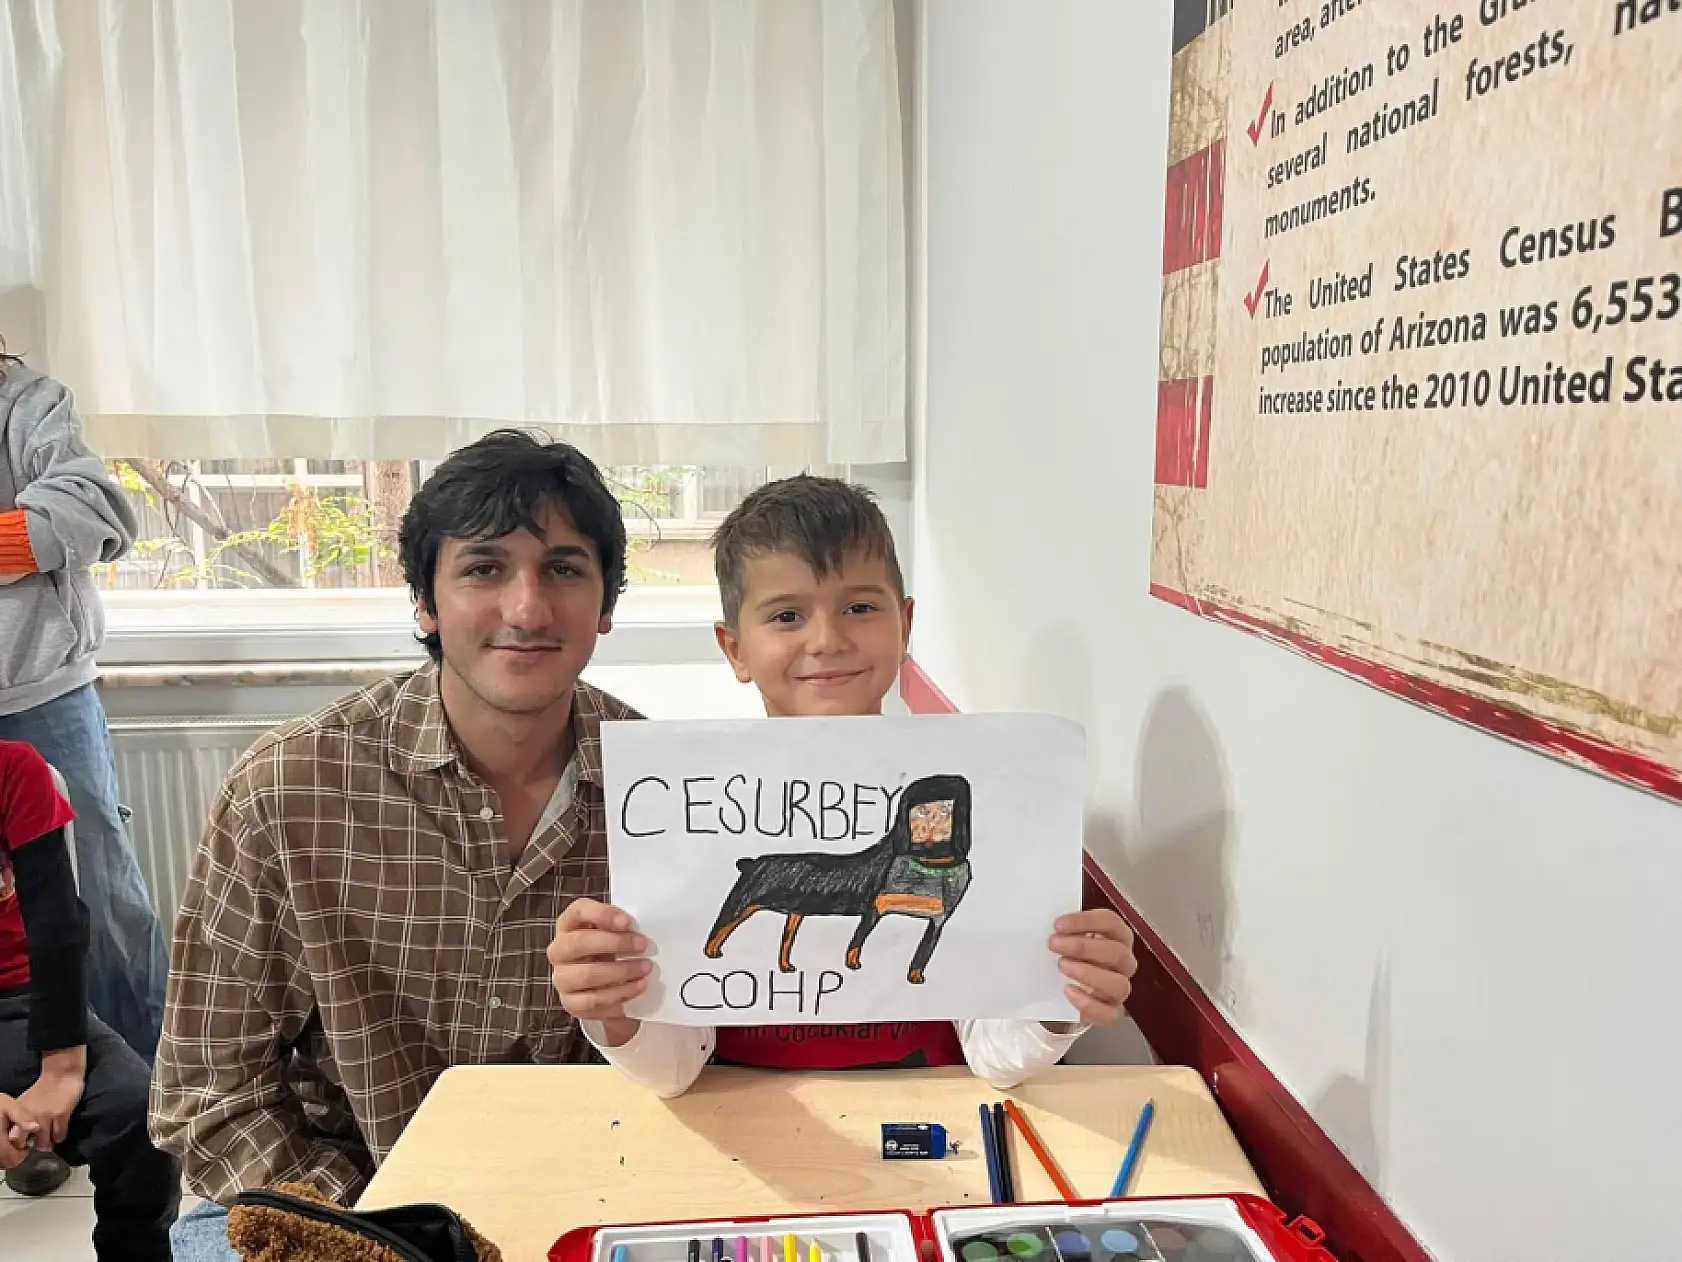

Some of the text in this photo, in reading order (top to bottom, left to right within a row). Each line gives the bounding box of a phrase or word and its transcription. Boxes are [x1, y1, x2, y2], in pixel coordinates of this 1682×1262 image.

[1275, 17, 1316, 59] area,
[1267, 132, 1328, 188] several
[1346, 77, 1439, 154] national
[1466, 29, 1574, 101] forests,
[1270, 109, 1286, 138] In
[1295, 62, 1374, 128] addition
[1387, 43, 1410, 76] to
[1423, 14, 1463, 57] the
[1265, 176, 1376, 238] monuments.
[1264, 289, 1292, 319] The
[1309, 262, 1373, 310] United
[1394, 248, 1470, 291] States
[1500, 214, 1616, 269] Census
[1261, 272, 1682, 374] population of Arizona was 6,553
[1259, 387, 1323, 415] increase
[1327, 381, 1376, 413] since
[1381, 379, 1418, 410] the
[1424, 368, 1490, 409] 2010
[1499, 356, 1613, 404] United
[621, 774, 903, 840] CESURBEY
[680, 970, 844, 1014] COHP
